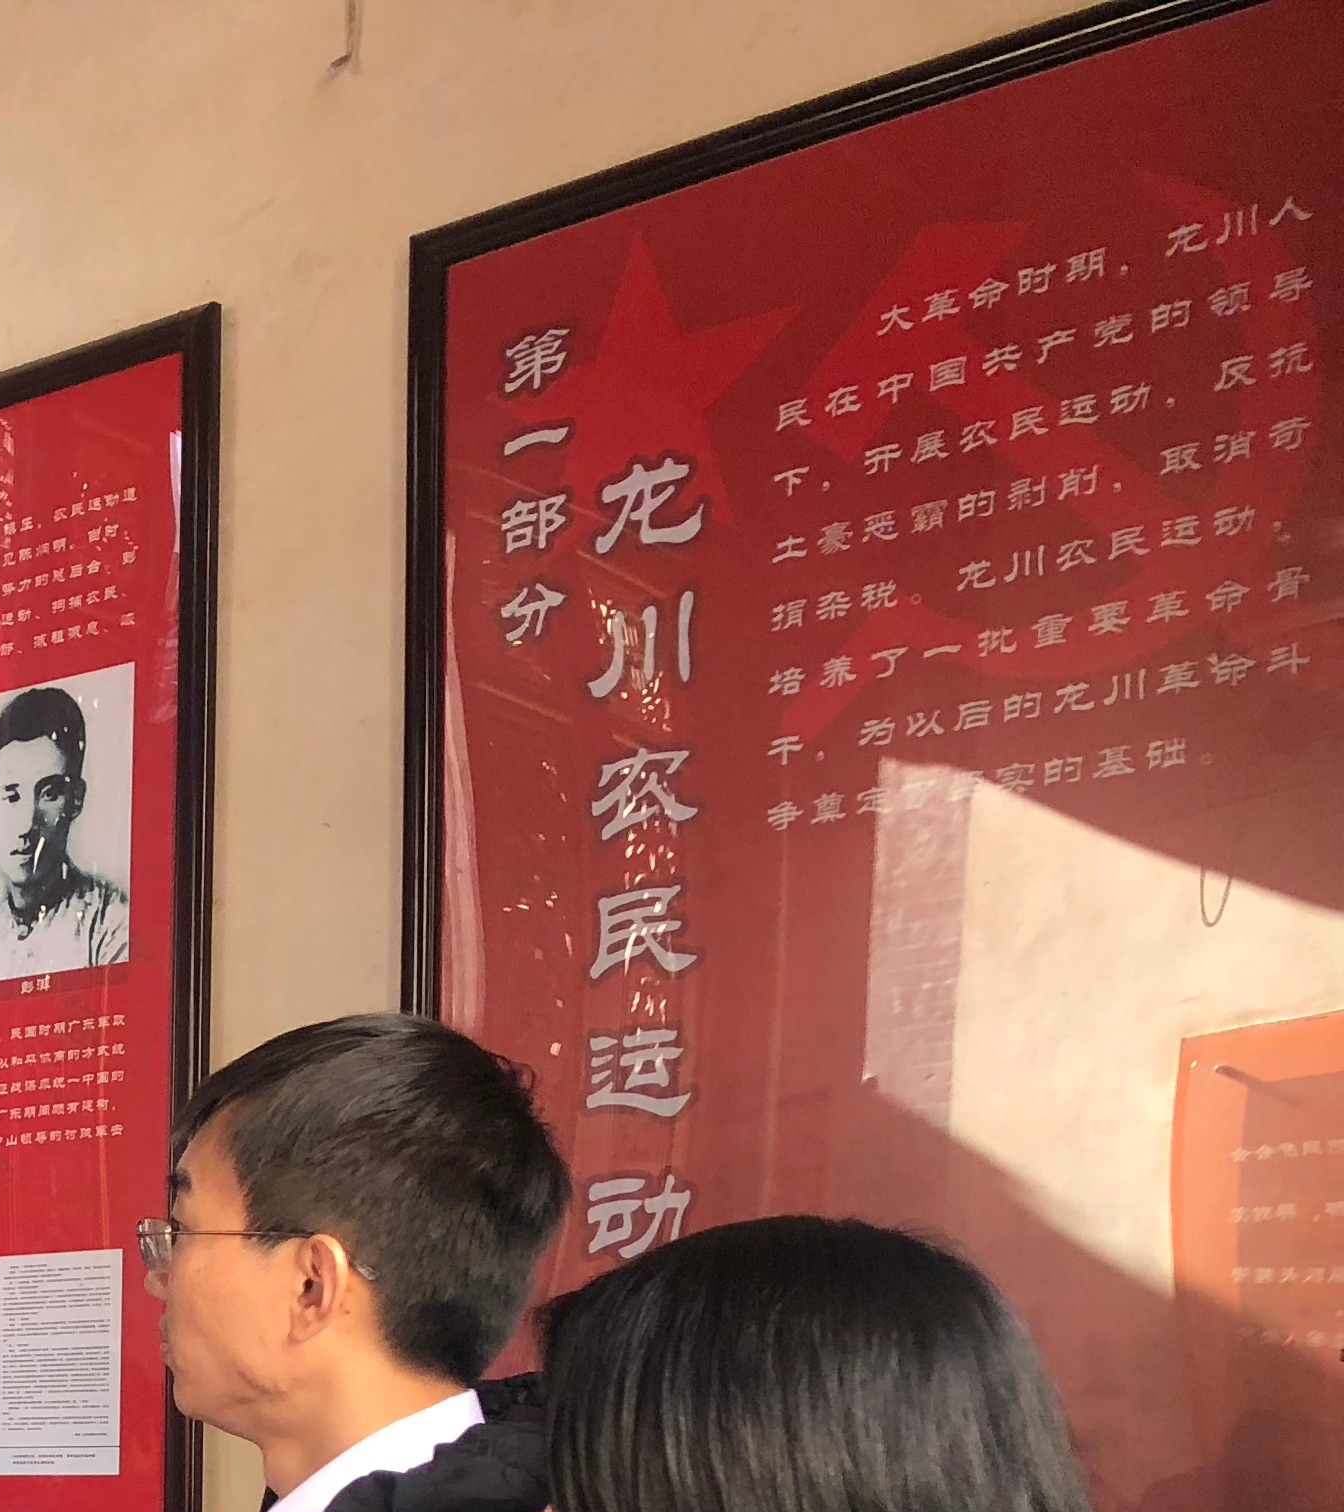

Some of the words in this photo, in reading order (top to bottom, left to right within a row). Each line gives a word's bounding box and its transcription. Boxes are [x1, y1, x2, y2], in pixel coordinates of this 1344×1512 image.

[877, 195, 1314, 338] 大革命时期，龙川人
[773, 341, 1314, 497] 下，开展农民运动，反抗
[774, 266, 1314, 435] 民在中国共产党的领导
[499, 327, 571, 645] 第一部分
[772, 416, 1312, 565] 土豪恶霸的剥削，取消苛
[769, 566, 1311, 700] 培养了一批重要革命骨
[771, 503, 1292, 634] 捐杂税。龙川农民运动，
[767, 641, 1312, 769] 干，为以后的龙川革命斗
[587, 456, 706, 1260] 龙川农民运动
[19, 975, 52, 996] 彭湃
